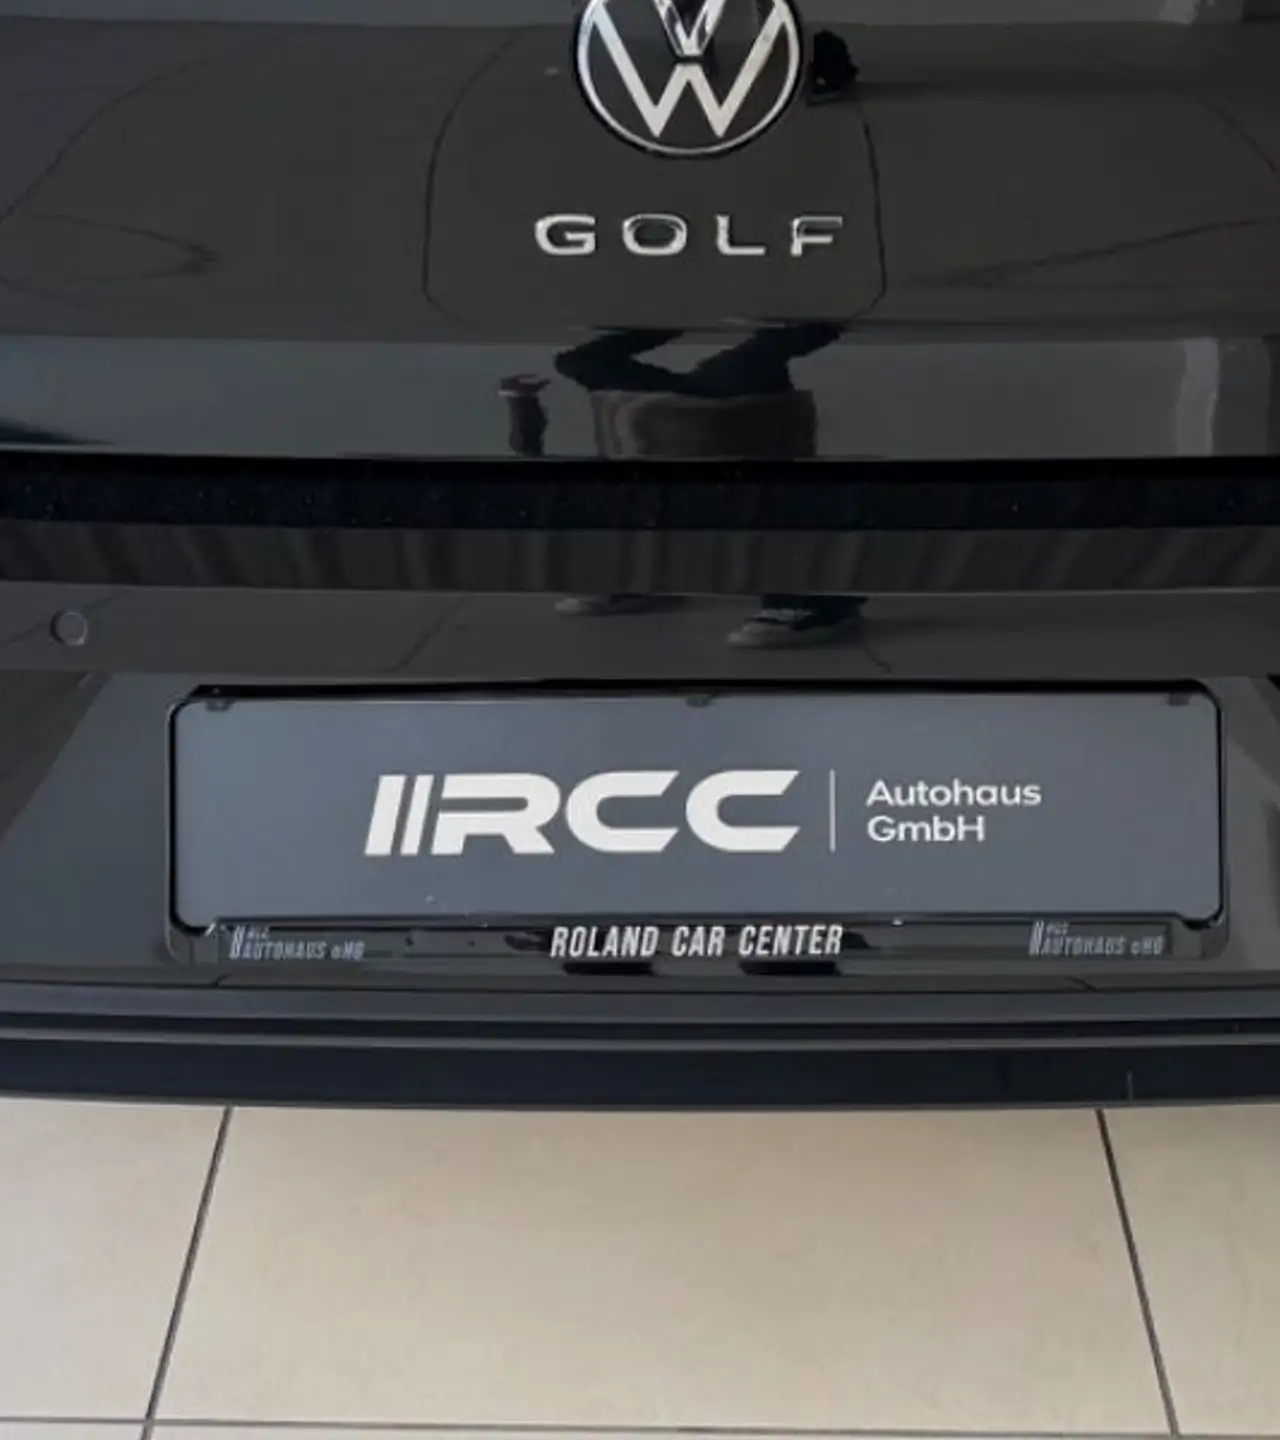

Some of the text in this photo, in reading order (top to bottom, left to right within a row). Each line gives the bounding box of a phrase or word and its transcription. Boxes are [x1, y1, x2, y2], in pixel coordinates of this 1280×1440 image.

[534, 213, 844, 257] GOLF
[865, 777, 1043, 807] Autohaus
[866, 814, 986, 843] GmbH
[549, 924, 844, 958] ROLAND CAR CENTER
